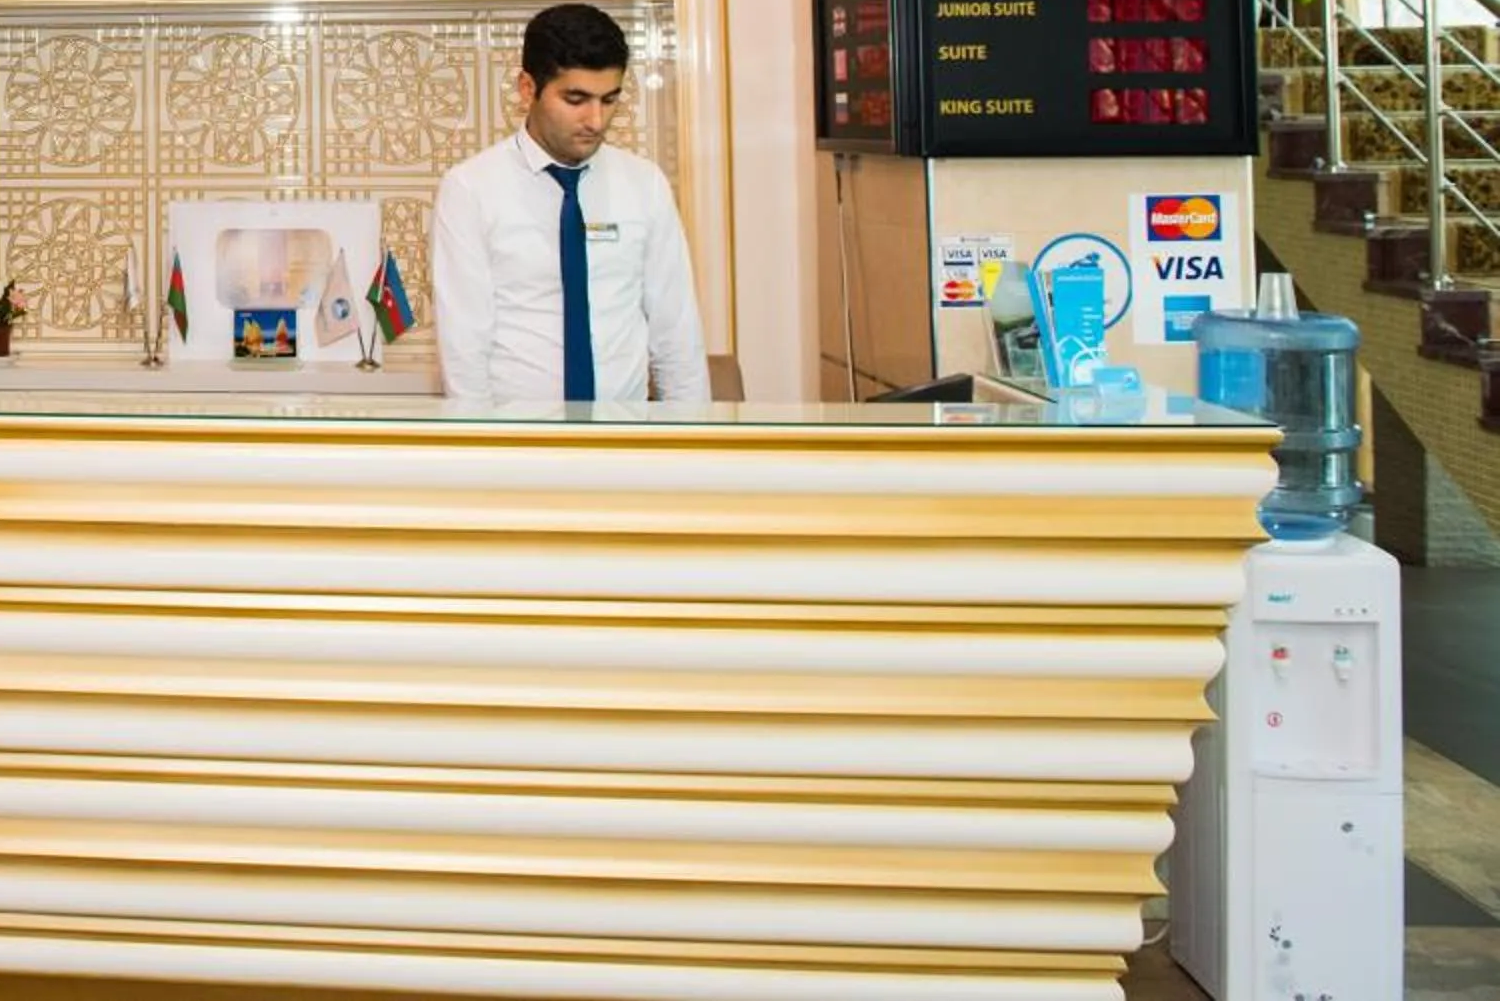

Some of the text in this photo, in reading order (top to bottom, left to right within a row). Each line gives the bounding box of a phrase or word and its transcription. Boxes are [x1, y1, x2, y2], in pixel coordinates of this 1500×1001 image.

[937, 1, 1036, 18] JUNIOR SUITE
[938, 45, 987, 61] SUITE
[940, 99, 1034, 115] KING SUITE
[1152, 255, 1224, 280] VISA
